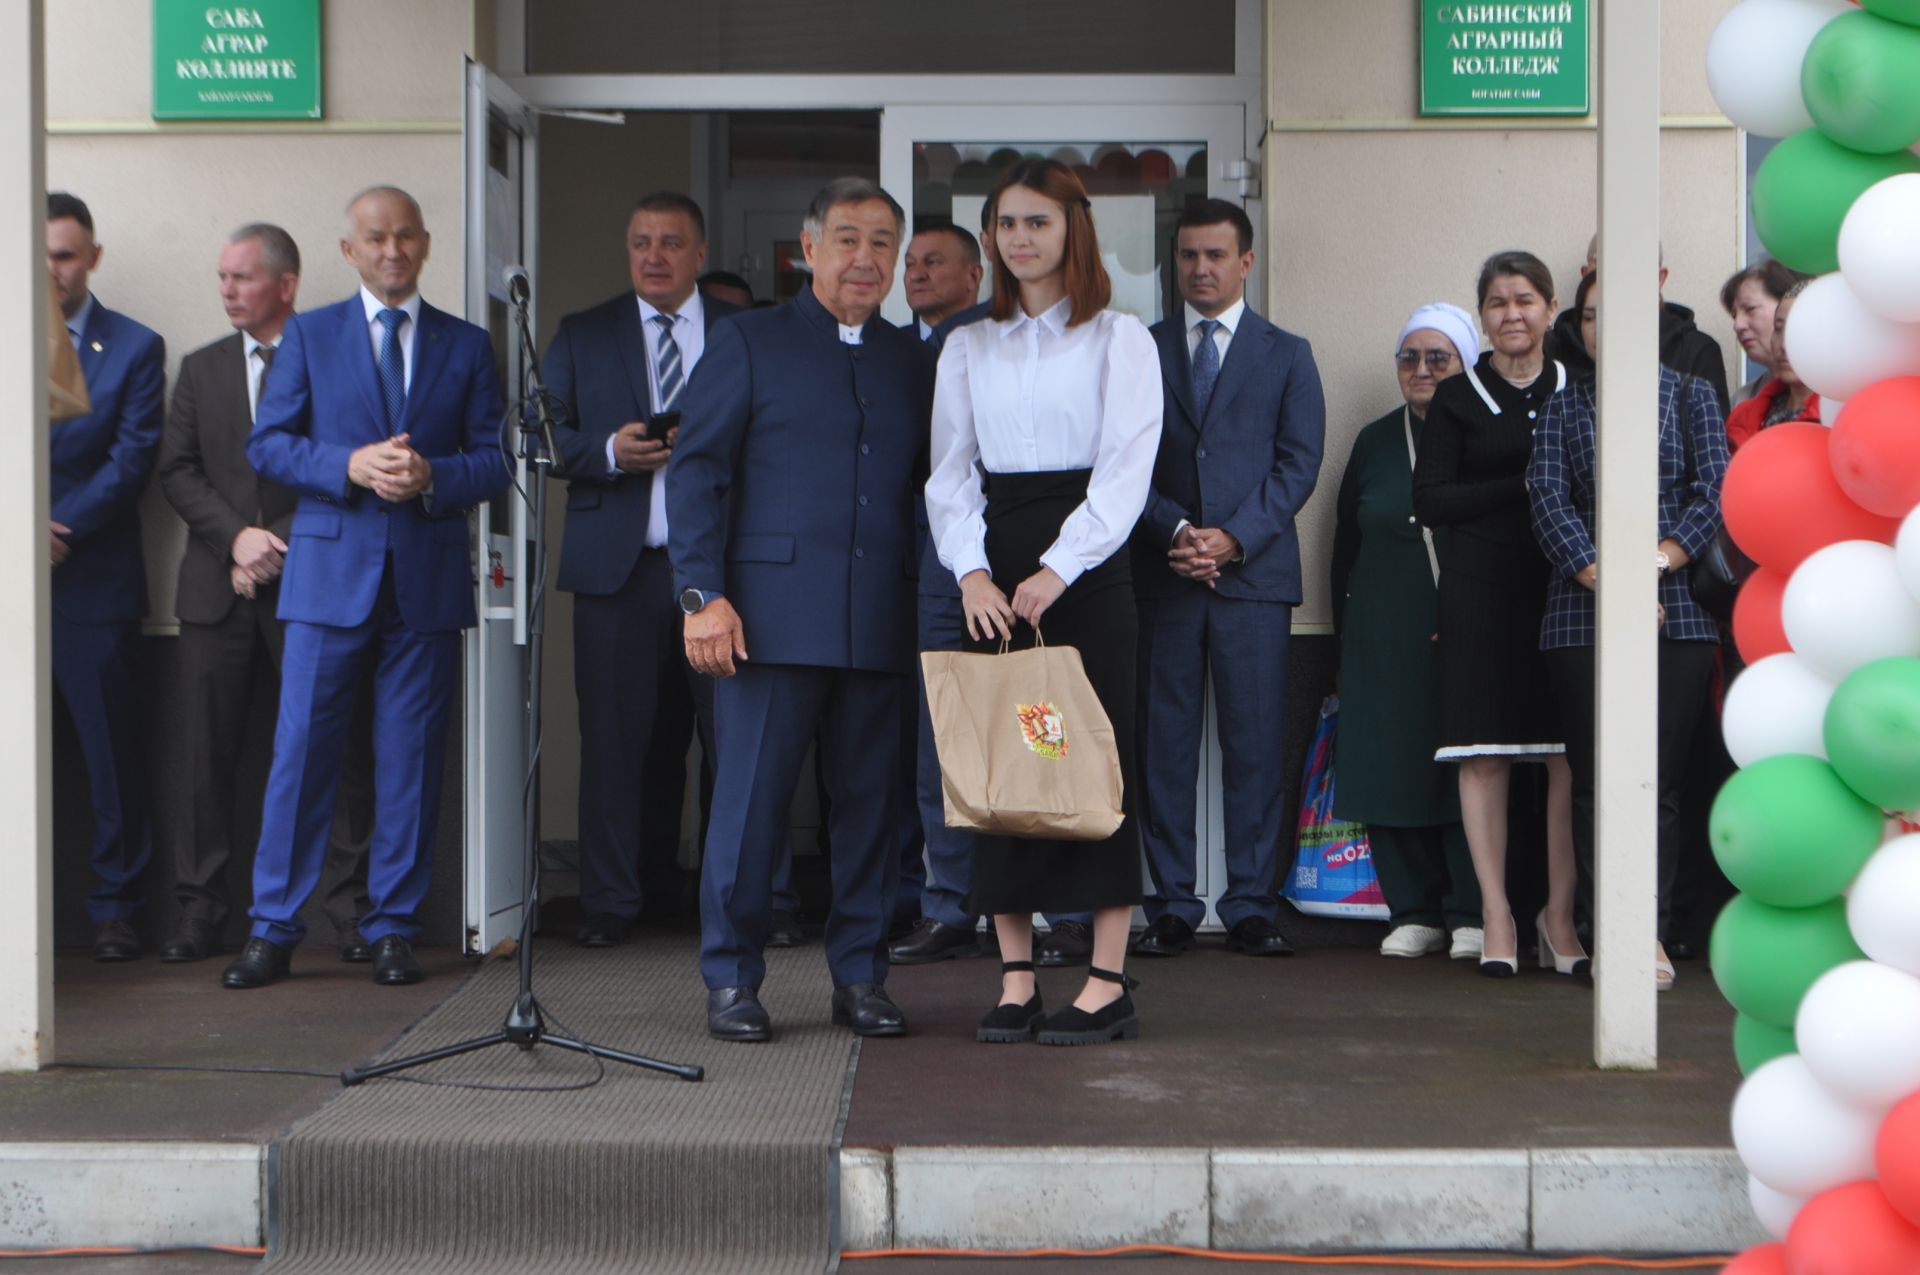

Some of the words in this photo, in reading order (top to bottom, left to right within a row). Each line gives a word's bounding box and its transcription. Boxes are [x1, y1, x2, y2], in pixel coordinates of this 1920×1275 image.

[1437, 1, 1572, 24] САБИНСКИЙ
[201, 33, 269, 54] АГРАР
[1447, 27, 1563, 50] АГРАРНЫЙ
[1452, 55, 1560, 77] КОЛЛЕДЖ
[1326, 853, 1343, 863] на
